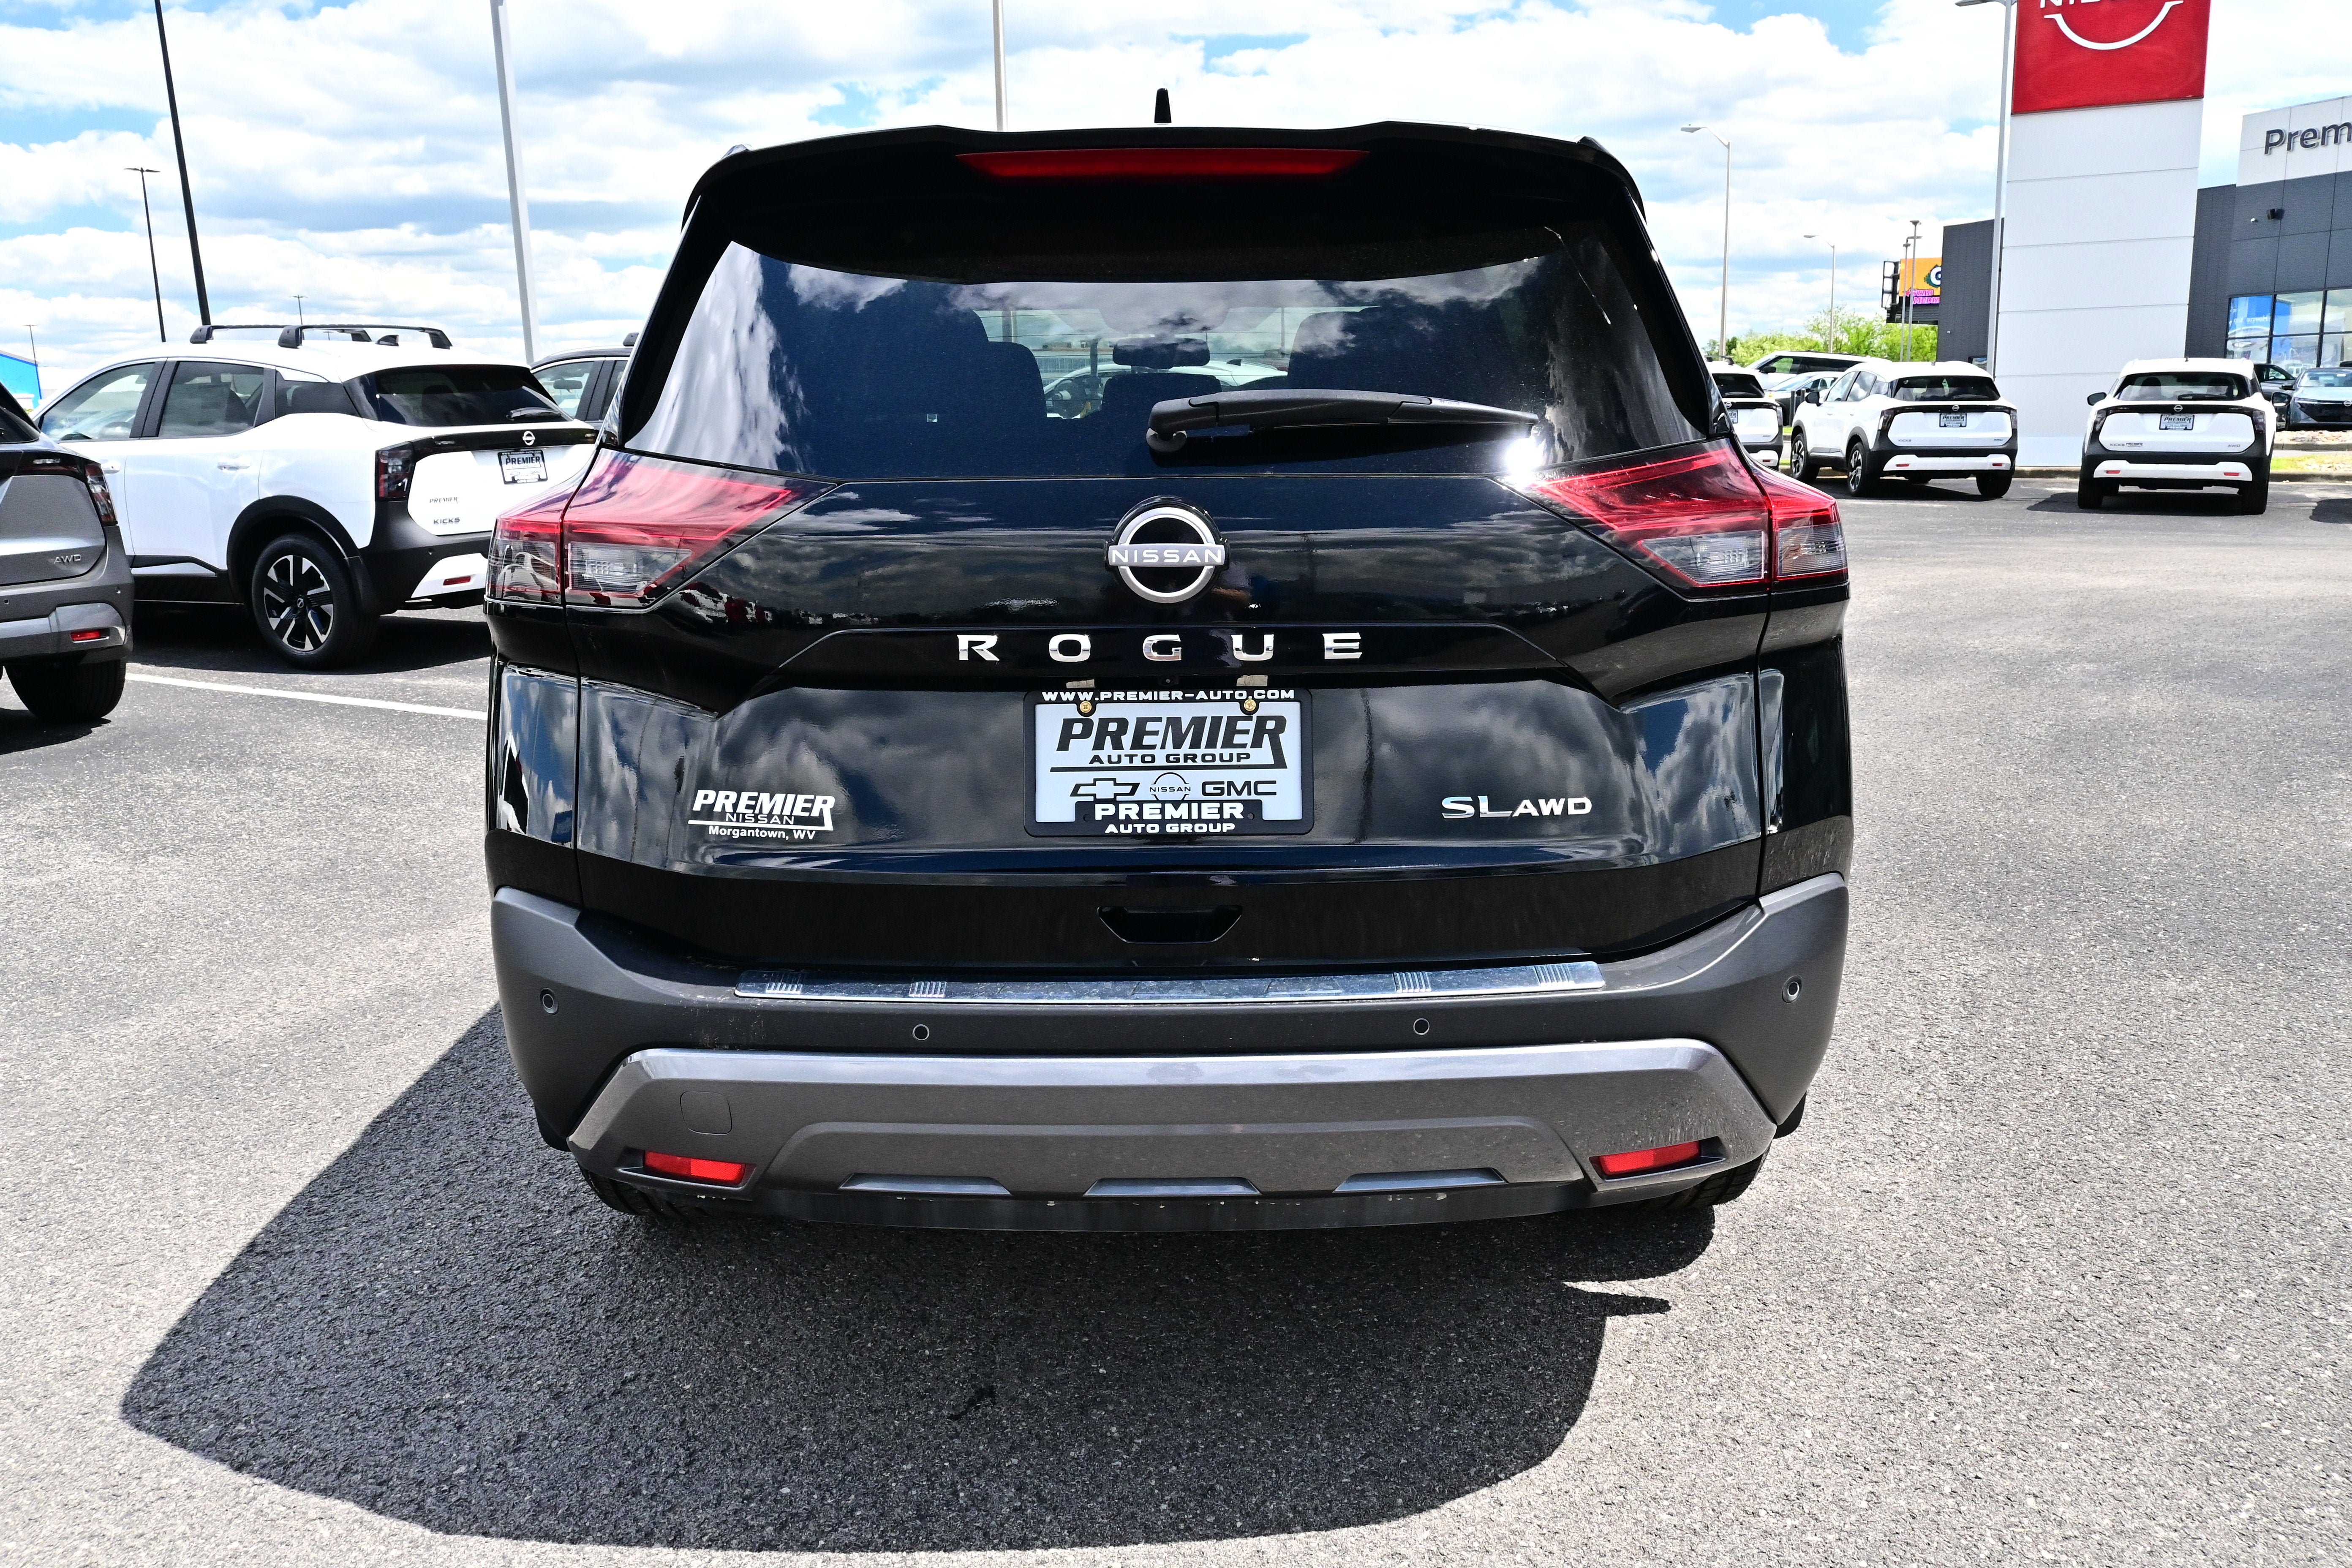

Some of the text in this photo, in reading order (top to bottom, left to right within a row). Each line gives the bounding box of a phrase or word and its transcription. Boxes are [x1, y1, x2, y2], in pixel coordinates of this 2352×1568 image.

[506, 456, 541, 466] PREMIER
[54, 554, 82, 564] AWD
[1112, 549, 1222, 563] NISSAN
[956, 632, 1362, 663] ROGUE
[1041, 689, 1295, 701] WWW.PREMIER-AUTO.COM
[1056, 715, 1287, 765] PREMIER
[1089, 752, 1251, 764] AUTO GROUP
[1201, 780, 1277, 796] GMC
[692, 789, 836, 826] PREMIER
[1094, 802, 1244, 820] PREMIER
[1441, 795, 1592, 819] SL AWD
[725, 813, 795, 825] NISSAN
[708, 825, 816, 841] Morgantown, WV
[1105, 823, 1236, 833] AUTO GROUP
